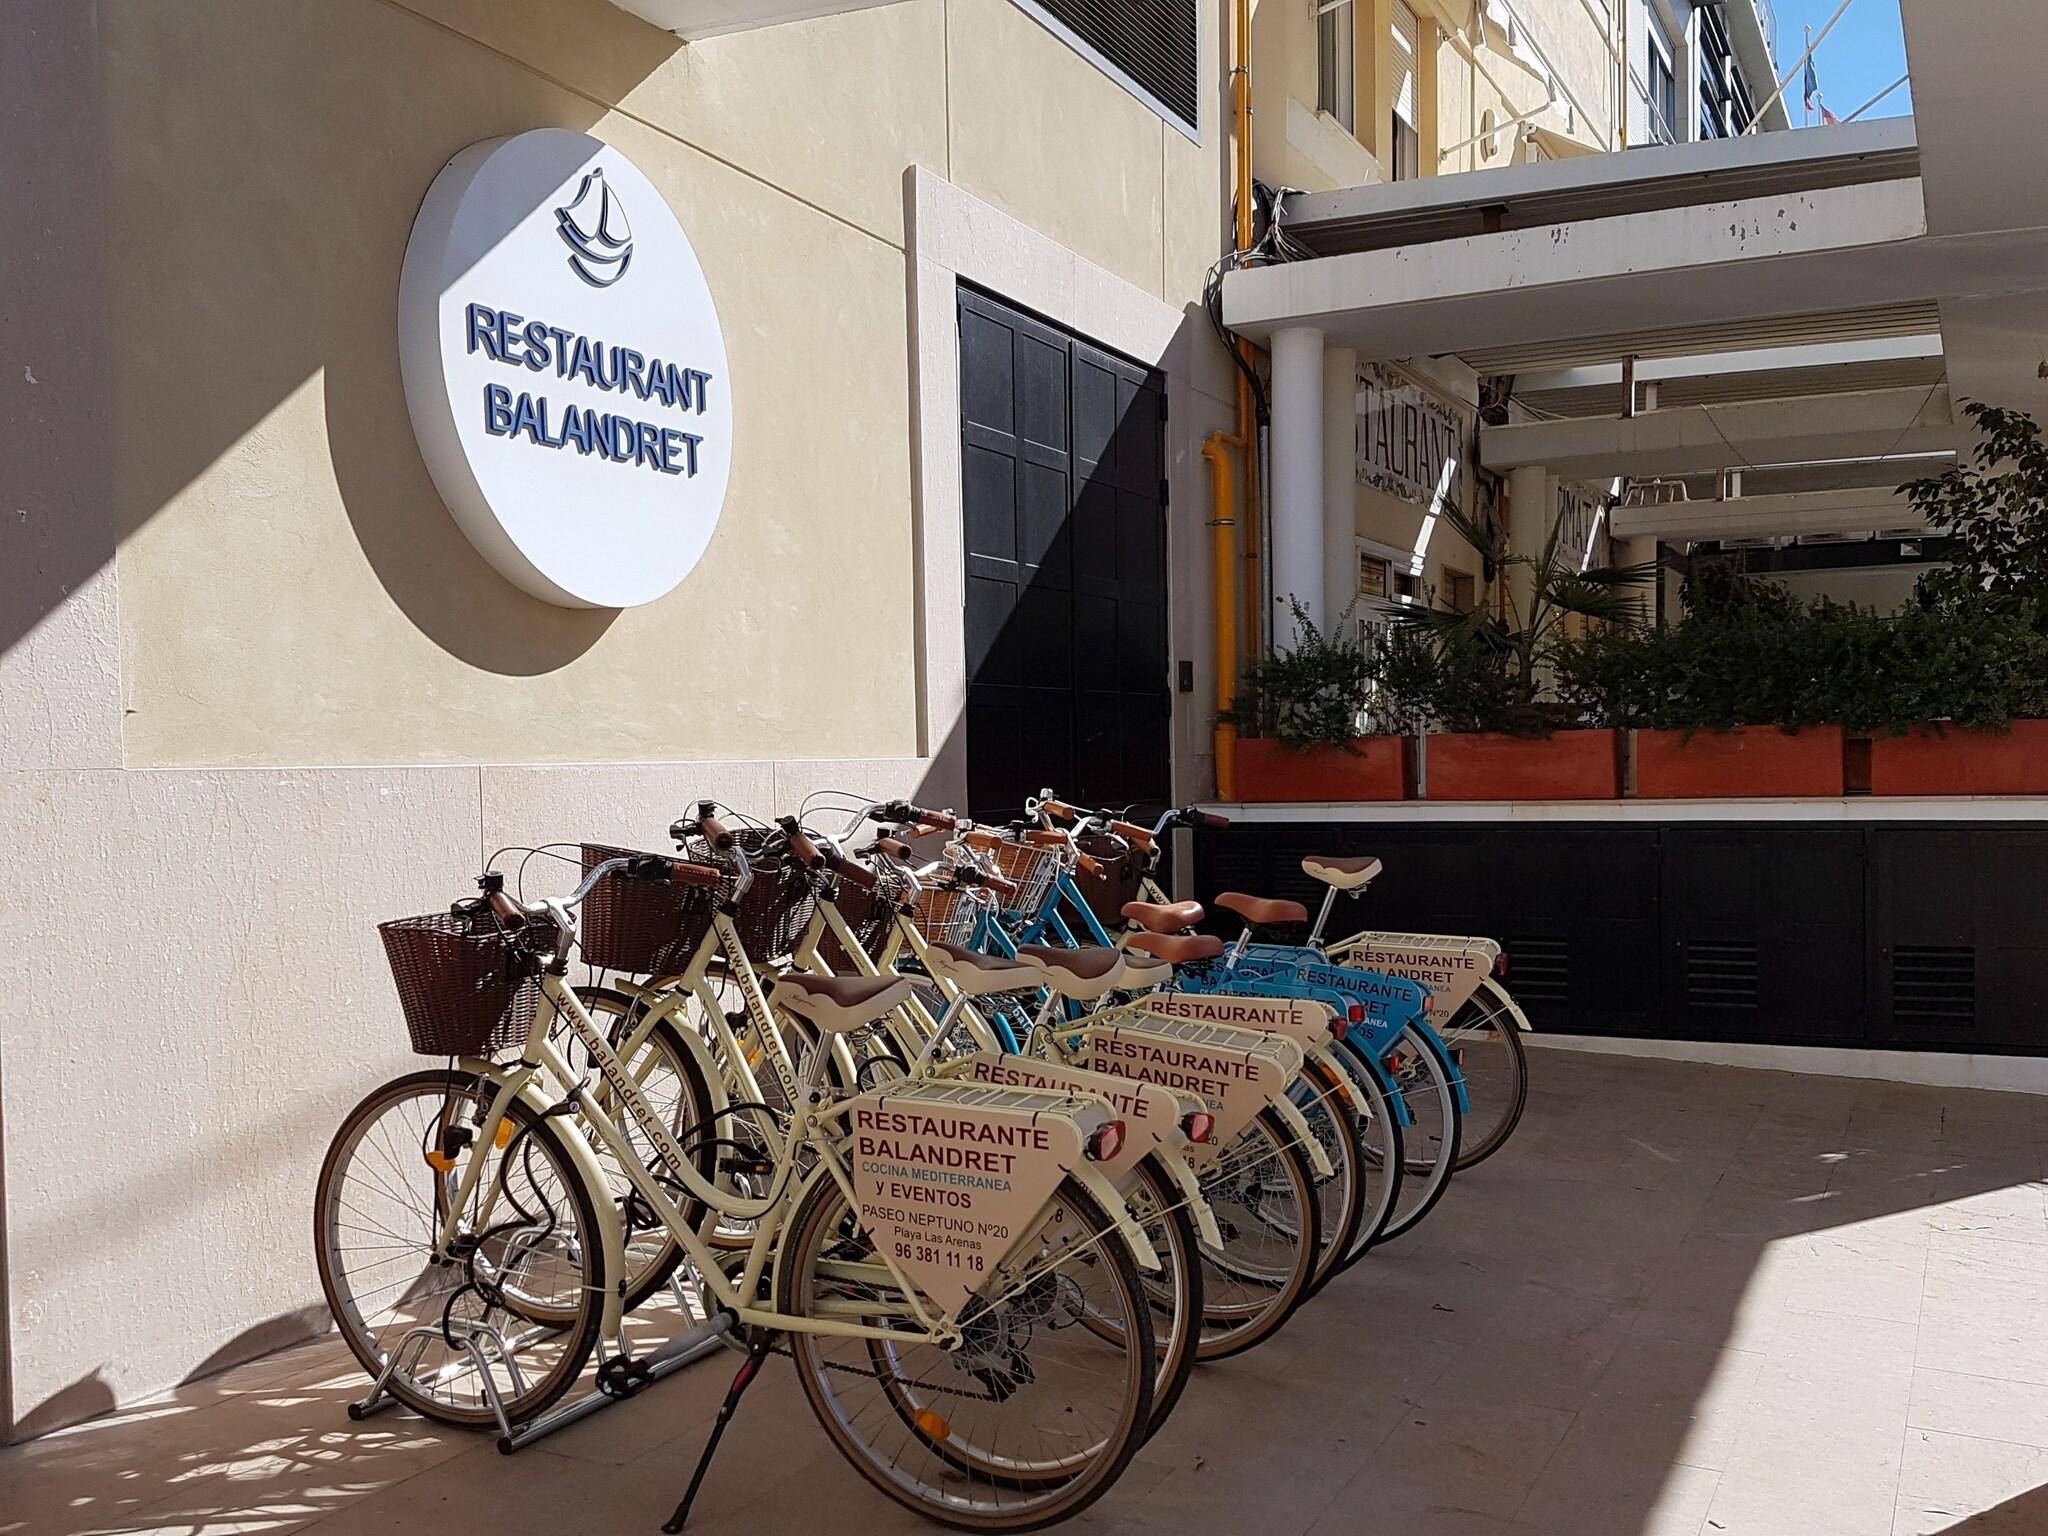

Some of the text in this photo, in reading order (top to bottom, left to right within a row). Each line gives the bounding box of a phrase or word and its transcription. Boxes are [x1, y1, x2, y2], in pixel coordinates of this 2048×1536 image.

[465, 302, 712, 415] RESTAURANT
[484, 382, 703, 478] BALANDRET
[1356, 374, 1455, 498] TAURANT
[1353, 951, 1475, 970] RESTAURANTE
[1297, 967, 1413, 1002] RESTAURANTE
[721, 928, 799, 1101] www.balandret.com
[1151, 1001, 1304, 1026] RESTAURANTE
[1094, 1037, 1259, 1082] RESTAURANTE
[1094, 1057, 1230, 1098] BALANDRET
[556, 991, 682, 1170] www.balandret.com
[857, 1109, 1050, 1151] RESTAURANTE
[859, 1136, 1017, 1174] BALANDRET
[862, 1161, 1013, 1192] COCINA MEDITERRANEA
[875, 1180, 972, 1209] y EVENTOS
[862, 1203, 905, 1223] PASEO
[908, 1211, 974, 1234] NEPTUNO
[894, 1225, 983, 1251] Playa Las Arenas
[895, 1242, 985, 1272] 96 381 11 18
